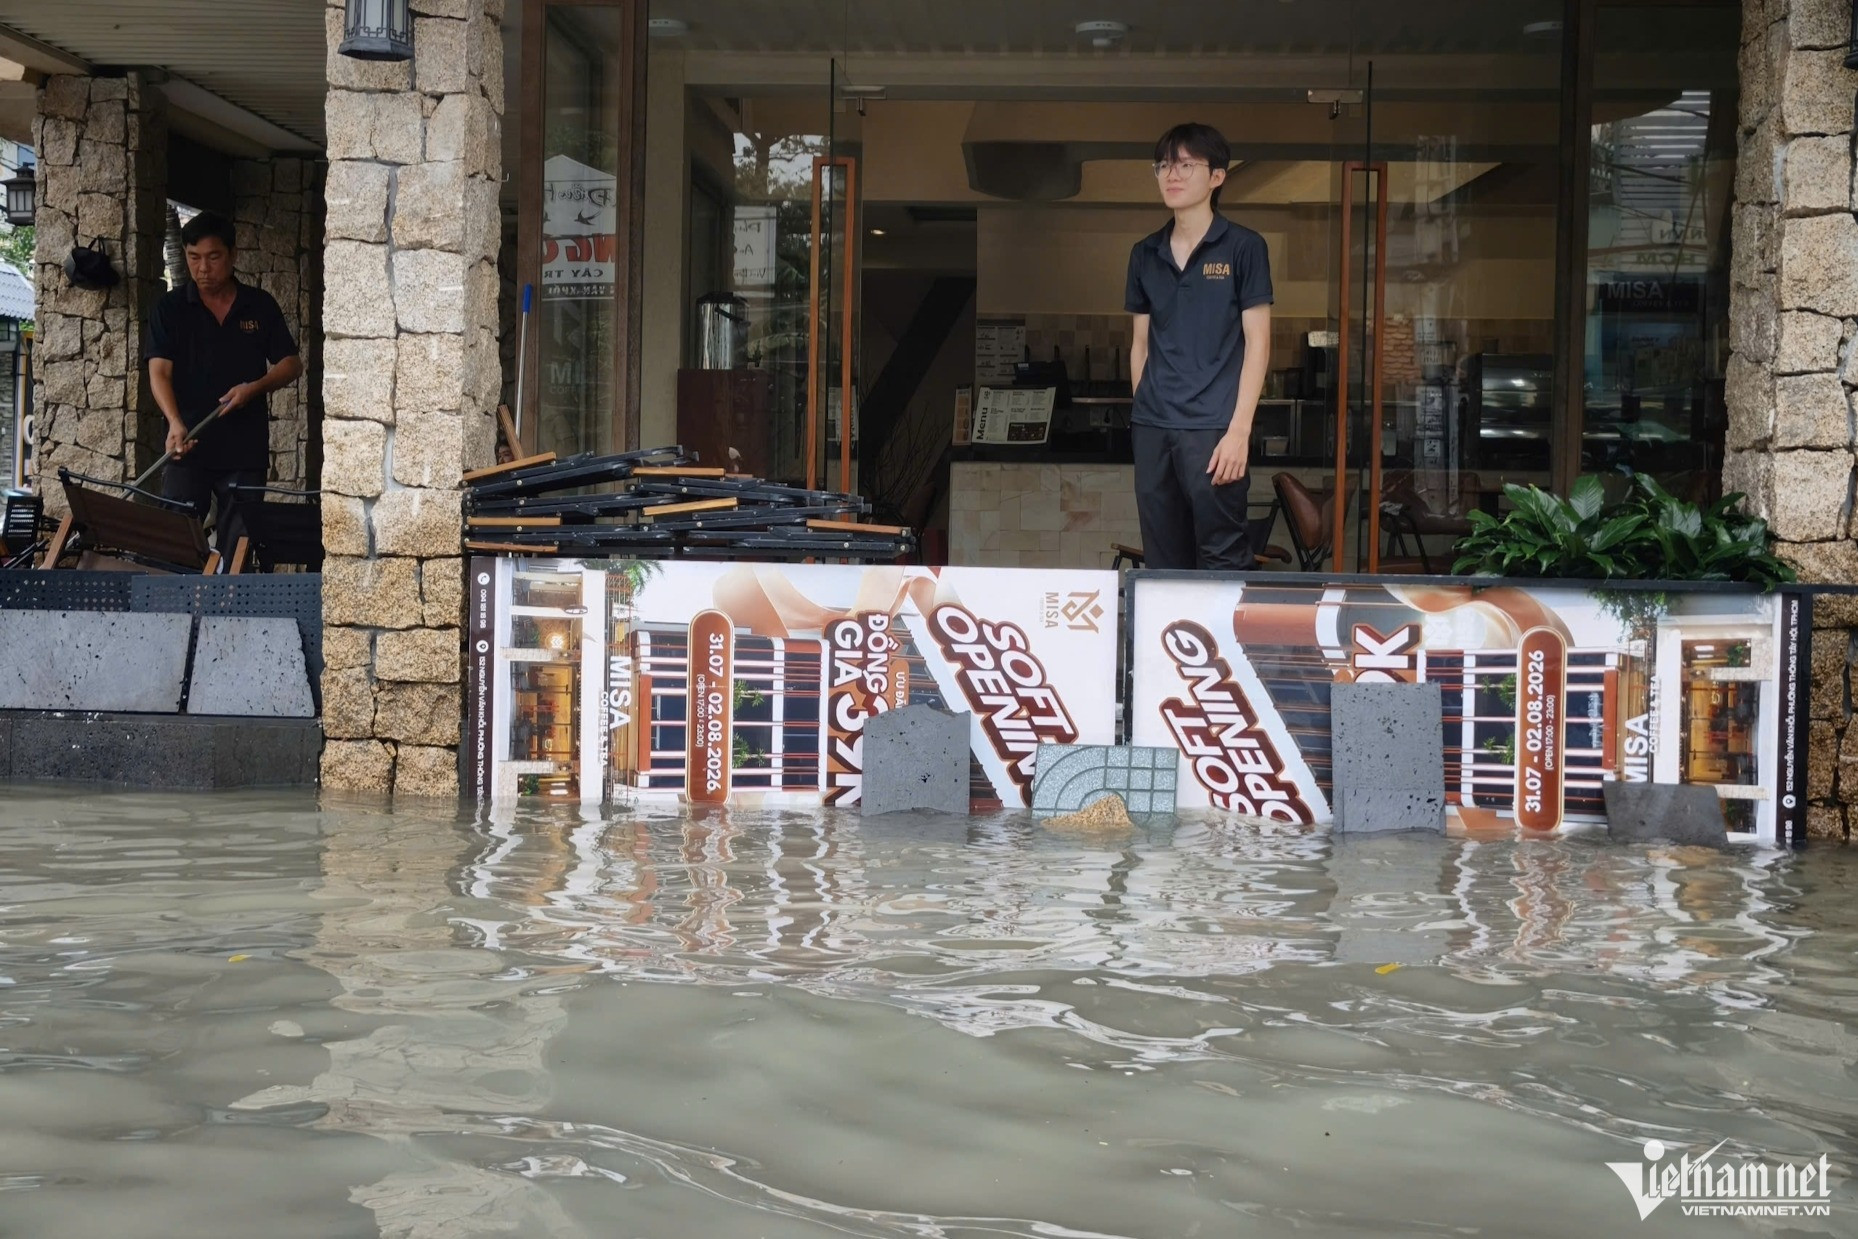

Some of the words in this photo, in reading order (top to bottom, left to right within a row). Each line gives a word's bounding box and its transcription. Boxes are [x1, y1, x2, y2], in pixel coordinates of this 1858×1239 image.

[1202, 263, 1230, 276] MISA
[1607, 280, 1663, 299] MISA
[976, 407, 988, 440] Menu
[1045, 592, 1059, 628] MISA
[708, 632, 724, 677] 31.07
[834, 620, 871, 686] GIÁ
[866, 614, 898, 694] ĐỒNG
[609, 656, 632, 730] MISA
[696, 674, 705, 698] (OPEN
[896, 672, 906, 688] ƯU
[936, 606, 1039, 778] OPENIN
[982, 623, 1075, 735] SOFT
[1650, 675, 1659, 696] TEA
[600, 691, 609, 732] COFFEE
[696, 699, 705, 718] 17:00
[1526, 650, 1544, 752] 02.08.2026
[1546, 695, 1556, 719] 23:00)
[1650, 699, 1659, 707] &
[695, 724, 704, 748] 23:00)
[706, 692, 722, 791] 02.08.2026
[1545, 726, 1554, 745] 17:00
[1624, 713, 1648, 782] MISA
[1649, 710, 1659, 753] COFFEE
[600, 747, 608, 766] TEA
[1545, 746, 1554, 770] (OPEN
[1525, 766, 1542, 813] 31.07
